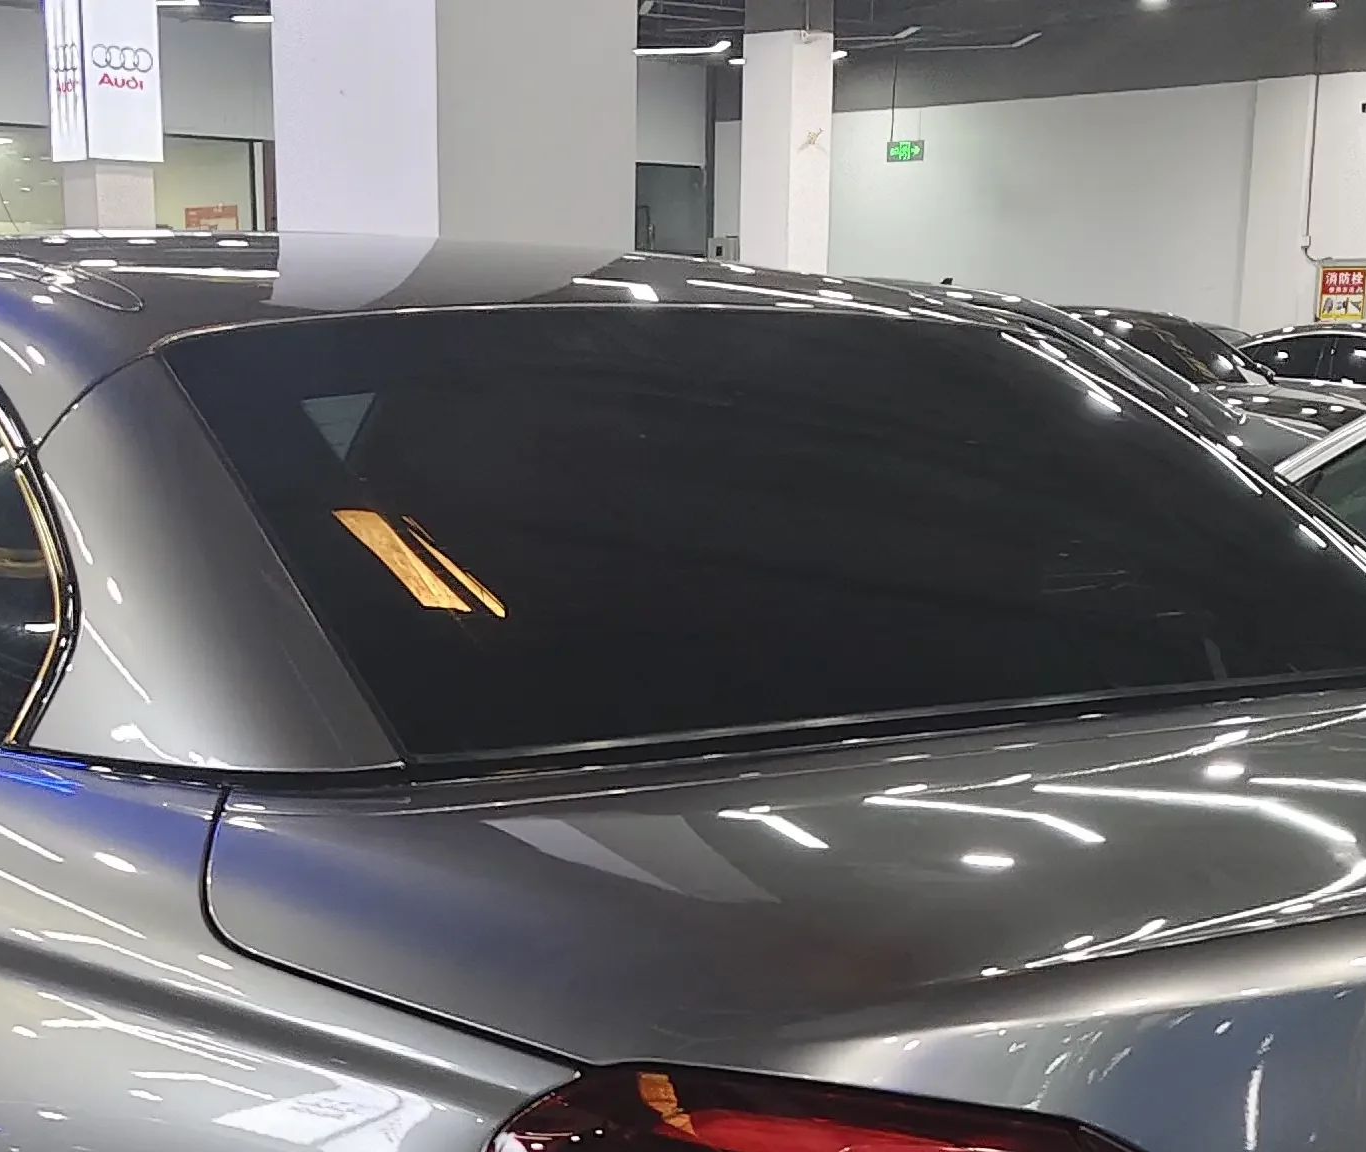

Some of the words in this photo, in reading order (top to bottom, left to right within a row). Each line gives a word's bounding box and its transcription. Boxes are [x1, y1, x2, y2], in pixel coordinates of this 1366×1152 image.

[98, 73, 144, 91] Audi
[1325, 271, 1364, 285] 消防栓
